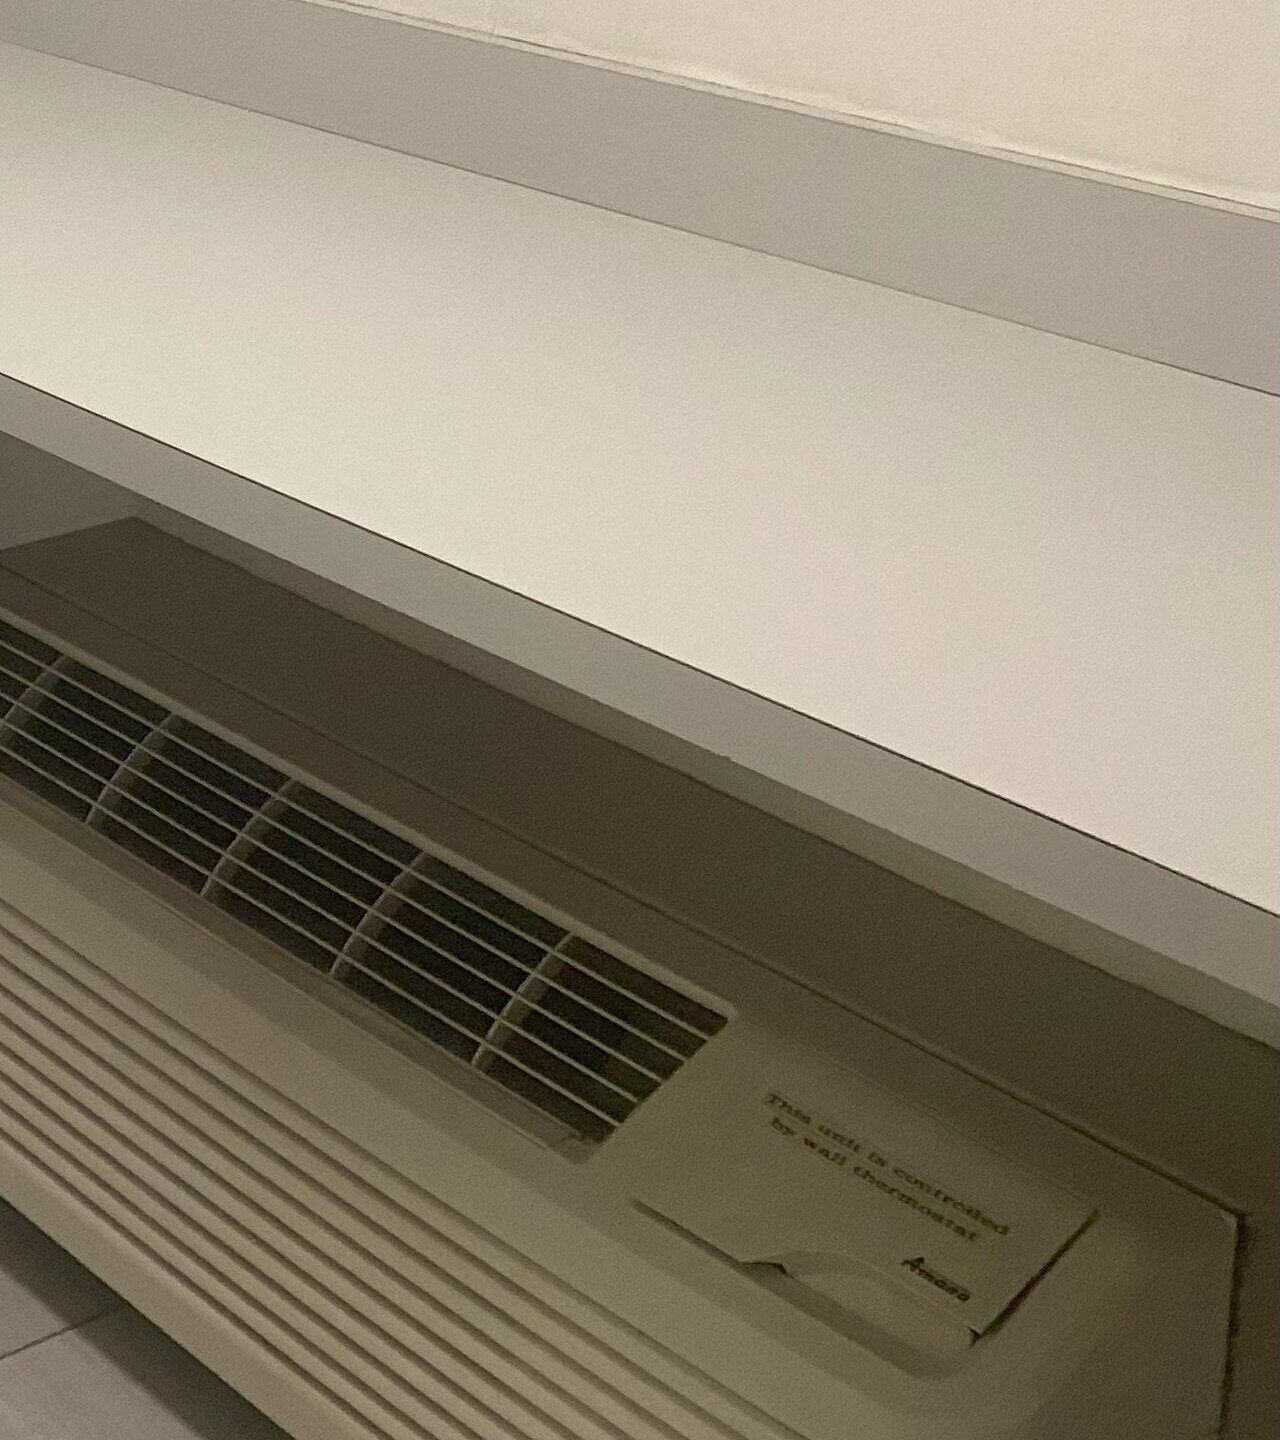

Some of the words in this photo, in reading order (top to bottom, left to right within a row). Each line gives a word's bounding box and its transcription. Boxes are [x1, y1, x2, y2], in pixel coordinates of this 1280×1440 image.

[767, 1093, 812, 1125] This
[818, 1123, 861, 1153] unit
[867, 1151, 888, 1168] is
[893, 1167, 1011, 1236] controlled
[770, 1116, 797, 1137] by
[803, 1136, 847, 1166] wall
[853, 1165, 978, 1241] thermostat
